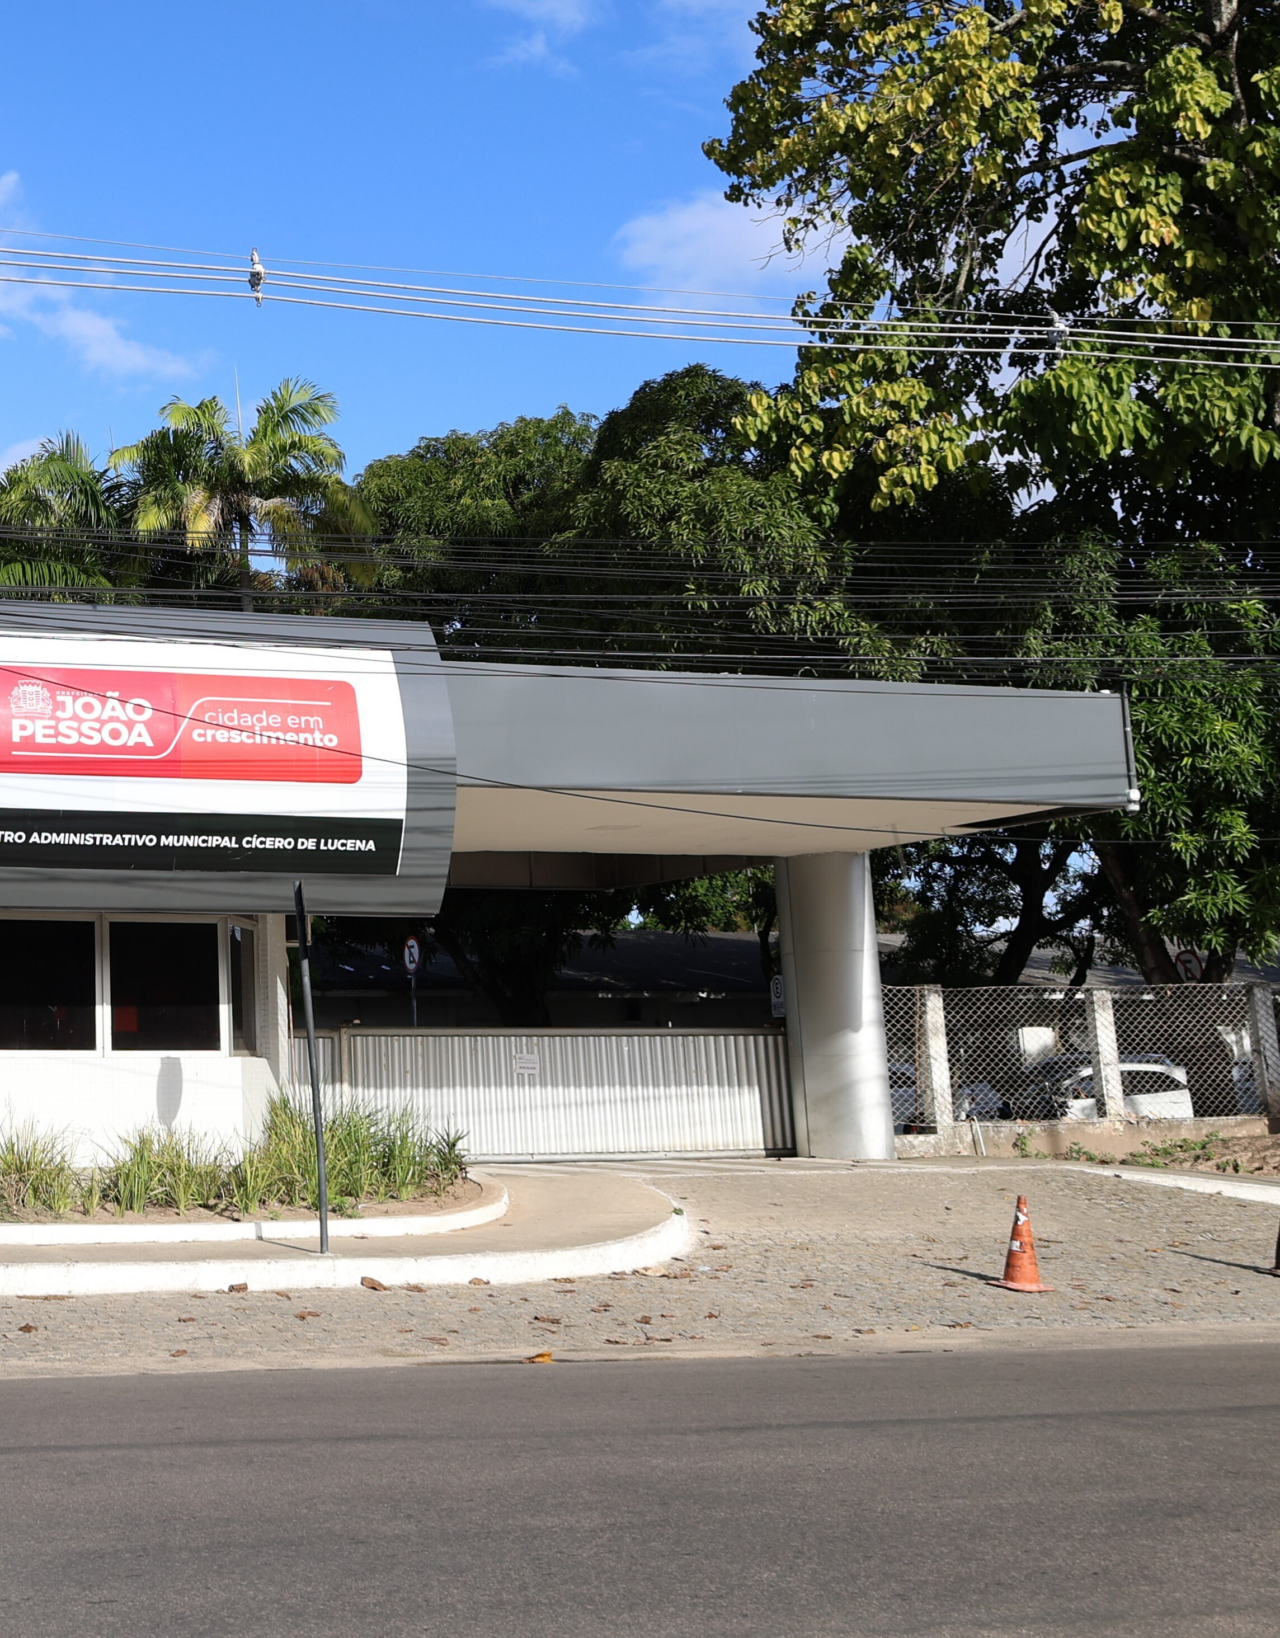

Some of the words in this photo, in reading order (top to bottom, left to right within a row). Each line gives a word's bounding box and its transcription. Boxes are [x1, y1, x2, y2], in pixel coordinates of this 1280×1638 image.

[55, 691, 153, 721] JOÃO
[204, 709, 281, 727] cidade
[287, 715, 323, 729] em
[11, 719, 154, 747] PESSOA
[192, 726, 338, 747] crescimento
[29, 832, 157, 847] ADMINISTRATIVO
[160, 835, 239, 848] MUNICIPAL
[242, 834, 295, 849] CÍCERO
[297, 838, 317, 850] DE
[320, 839, 376, 851] LUCENA
